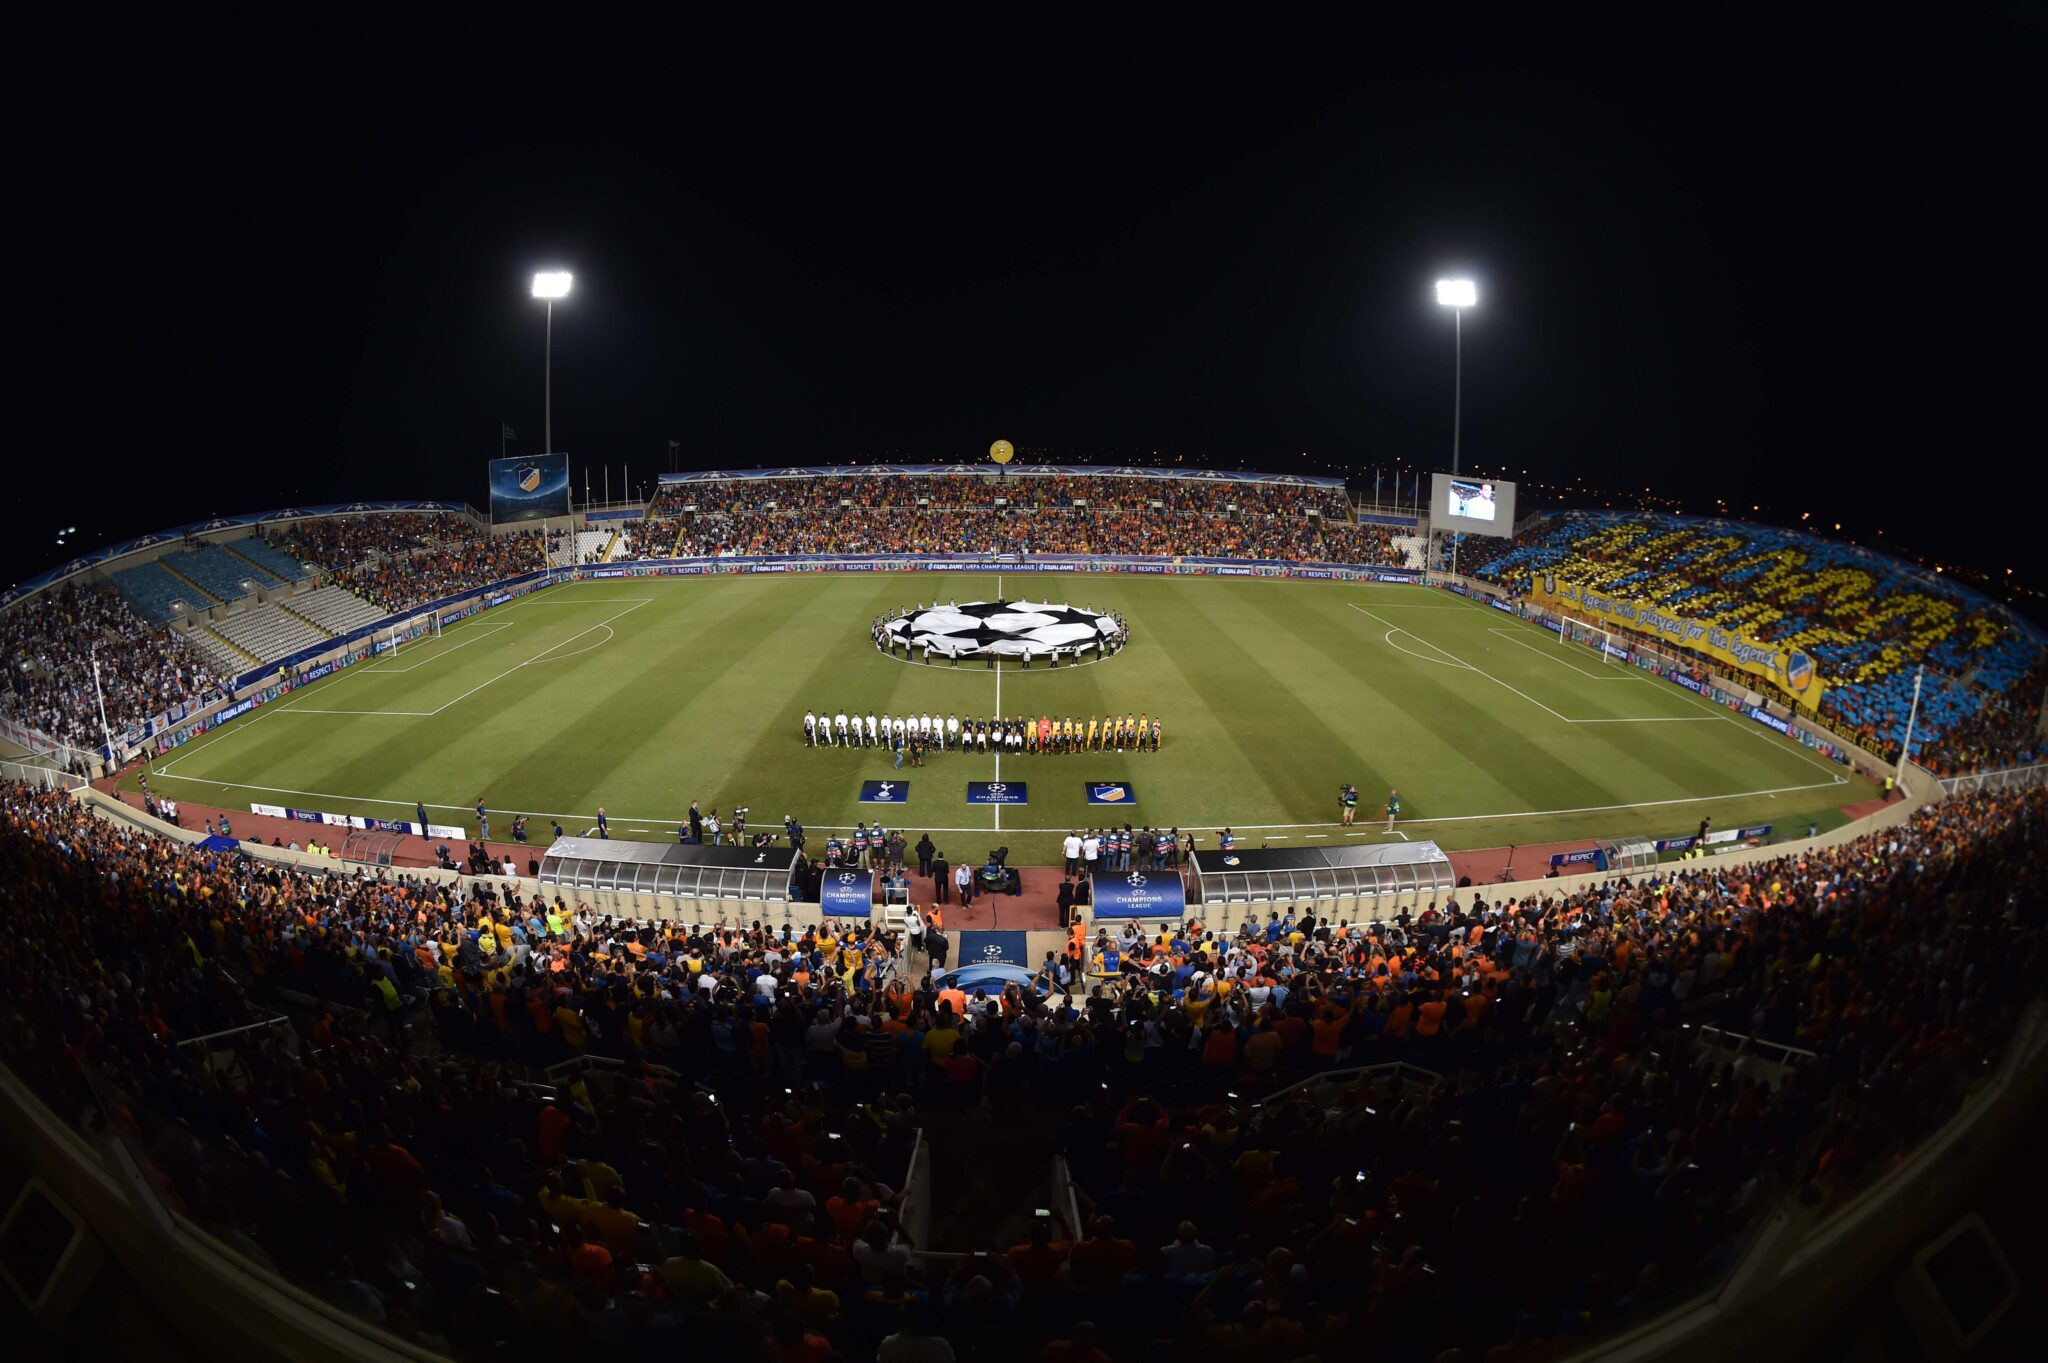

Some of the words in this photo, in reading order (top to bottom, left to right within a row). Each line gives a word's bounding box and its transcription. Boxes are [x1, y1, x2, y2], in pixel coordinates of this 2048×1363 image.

[444, 612, 460, 624] RESPECT
[1615, 599, 1636, 619] who
[1635, 606, 1685, 634] played
[1680, 619, 1705, 642] for
[1707, 625, 1728, 648] the
[309, 664, 331, 680] RESPECT
[1677, 674, 1701, 691] RESPECT
[237, 700, 252, 713] GAME
[1860, 734, 1891, 760] care
[298, 812, 316, 820] RESPECT
[430, 827, 453, 835] RESPECT
[1671, 840, 1689, 848] RESPECT
[1570, 852, 1594, 861] RESPECT
